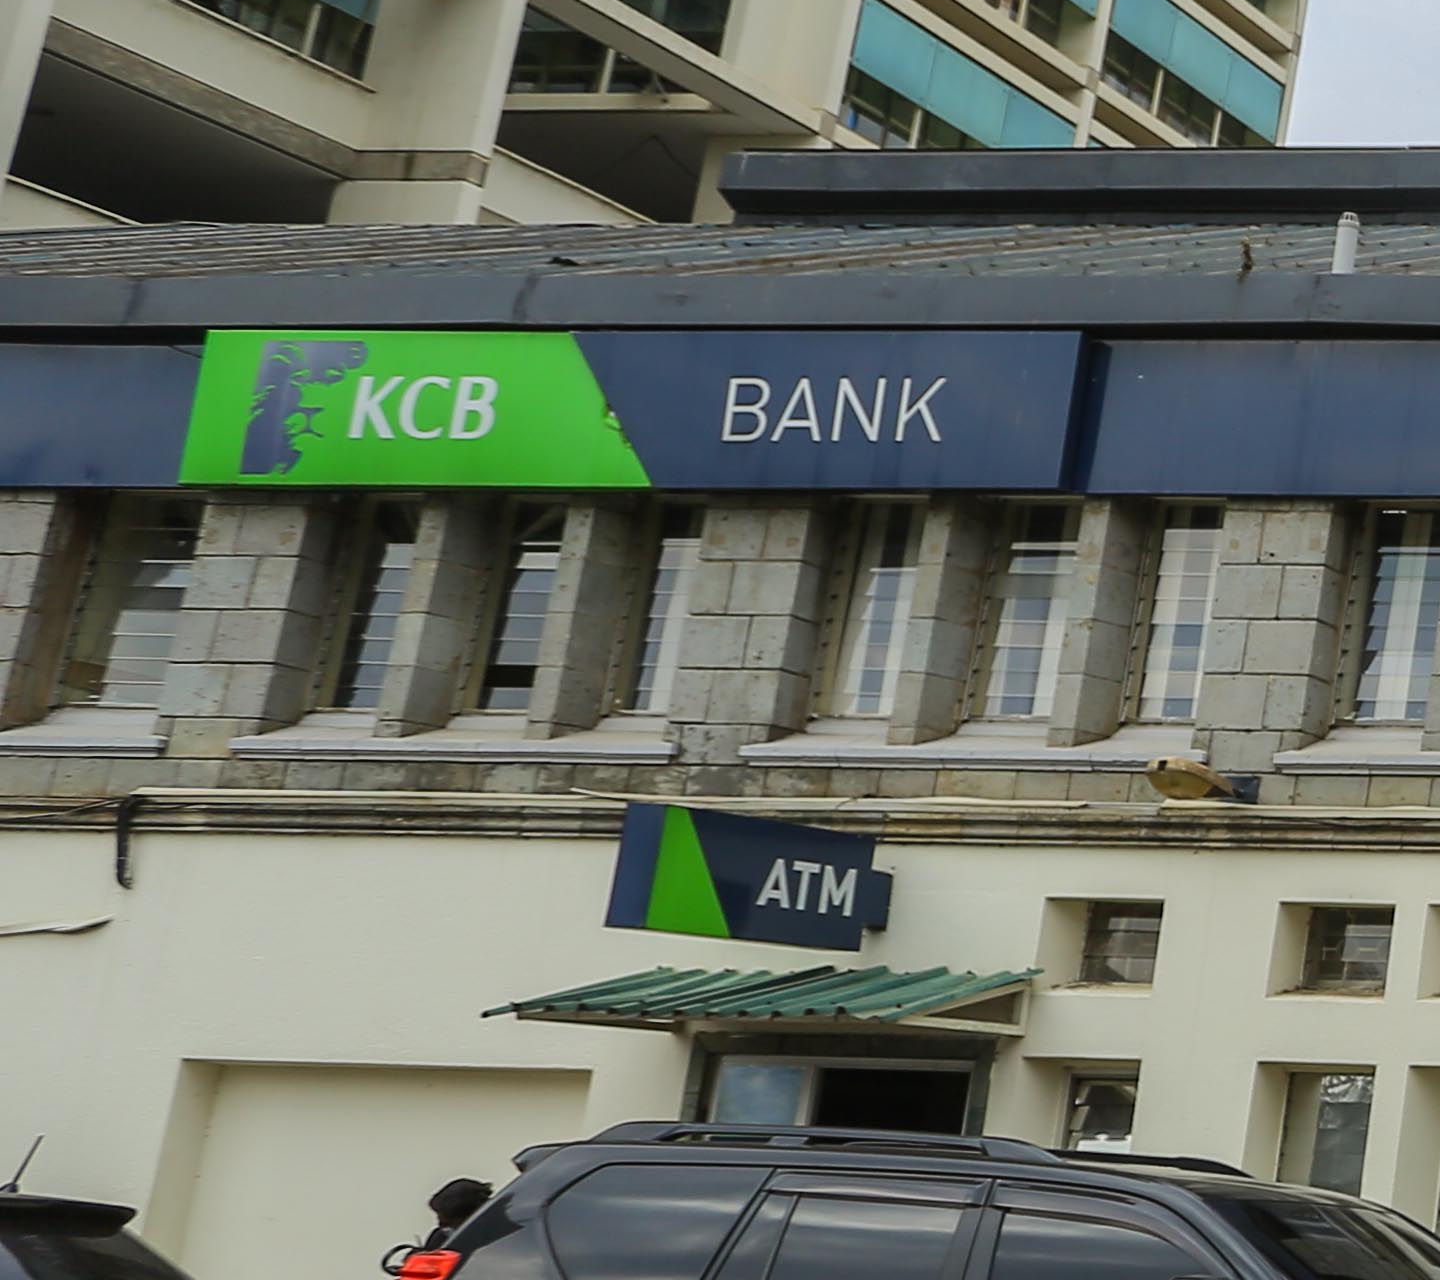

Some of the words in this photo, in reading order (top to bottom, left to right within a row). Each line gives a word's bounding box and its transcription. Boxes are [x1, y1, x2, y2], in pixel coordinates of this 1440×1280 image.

[347, 375, 499, 440] KCB
[720, 376, 948, 443] BANK
[755, 858, 859, 917] ATM
